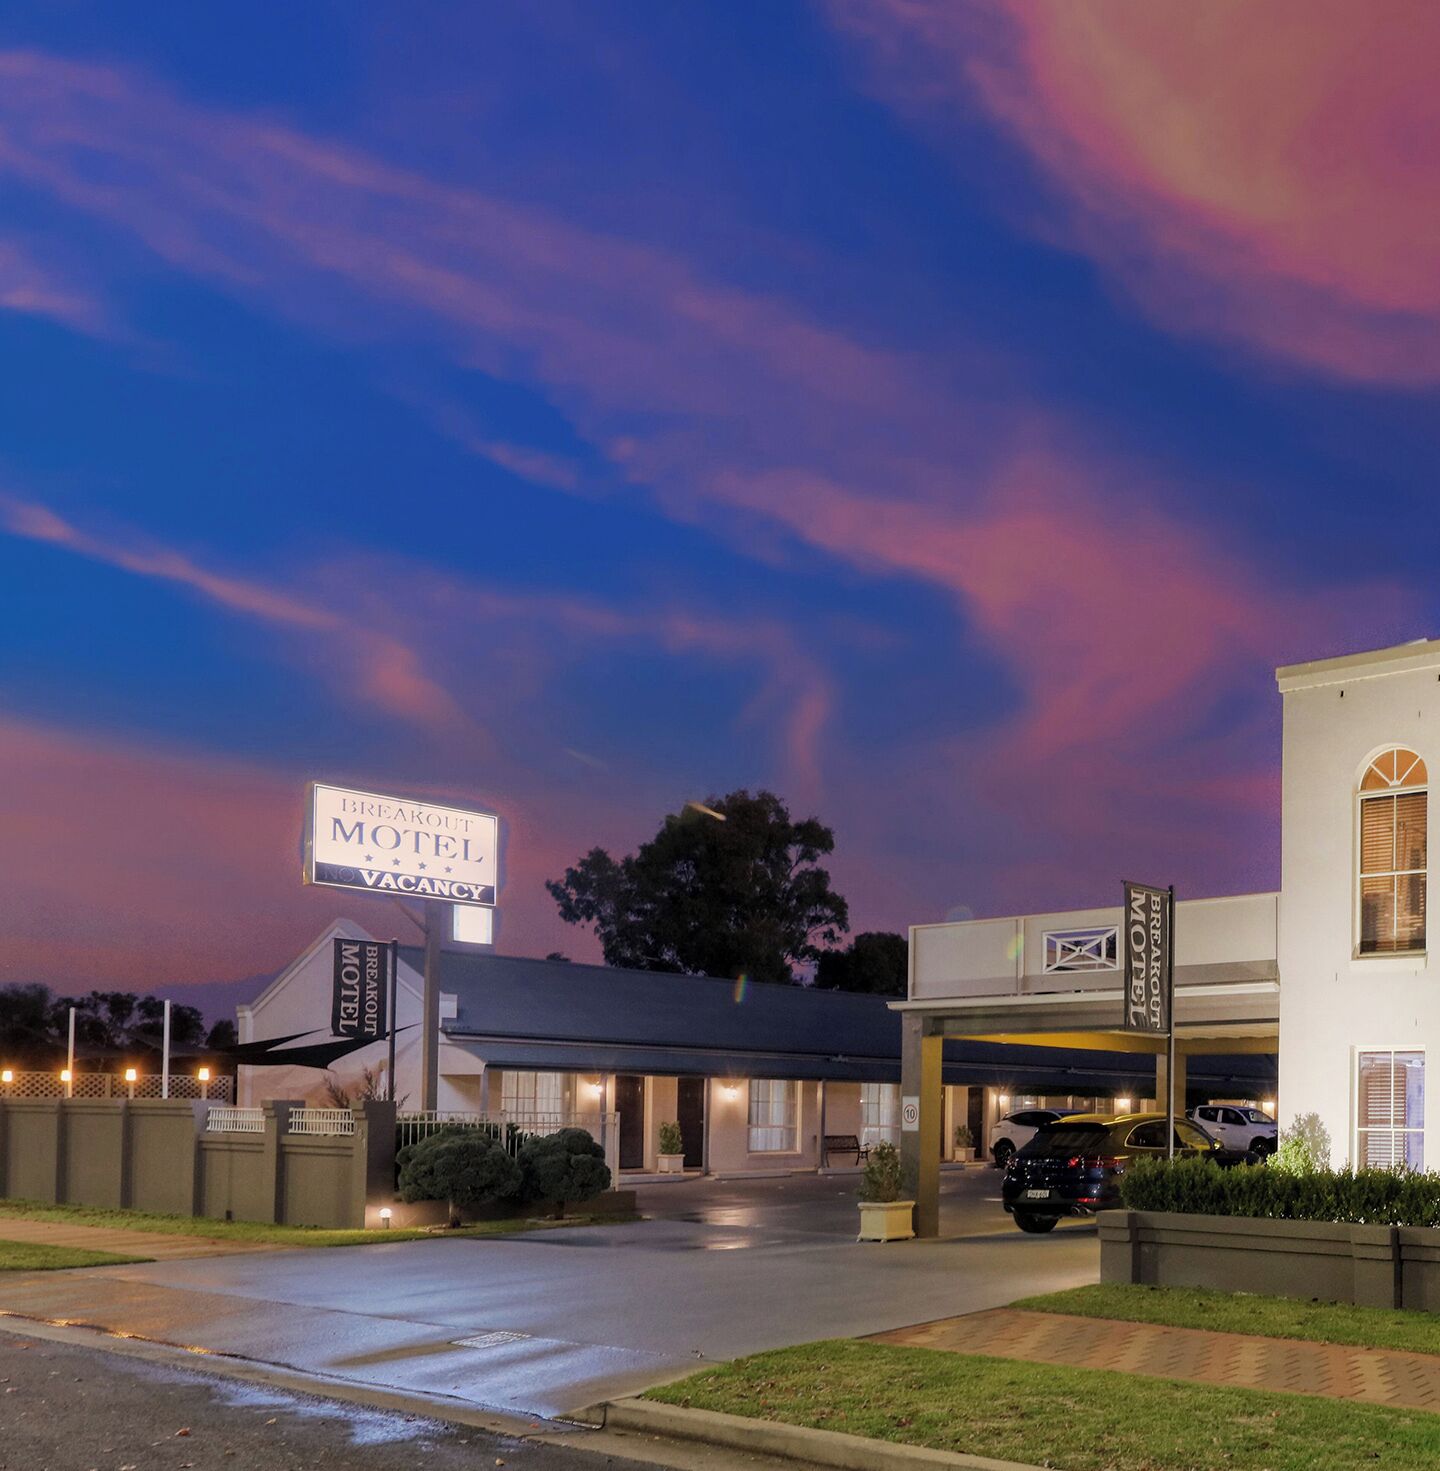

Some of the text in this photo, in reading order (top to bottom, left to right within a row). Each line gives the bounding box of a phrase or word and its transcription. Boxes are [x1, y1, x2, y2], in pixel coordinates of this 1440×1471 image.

[330, 816, 484, 863] MOTEL
[341, 798, 473, 833] BREAKOUT
[358, 869, 485, 900] VACANCY
[339, 943, 360, 1034] MOTEL
[364, 945, 378, 1036] BREAKOUT
[1130, 888, 1146, 1026] MOTEL
[1150, 894, 1161, 1029] BREAKOUT
[906, 1108, 915, 1119] 10
